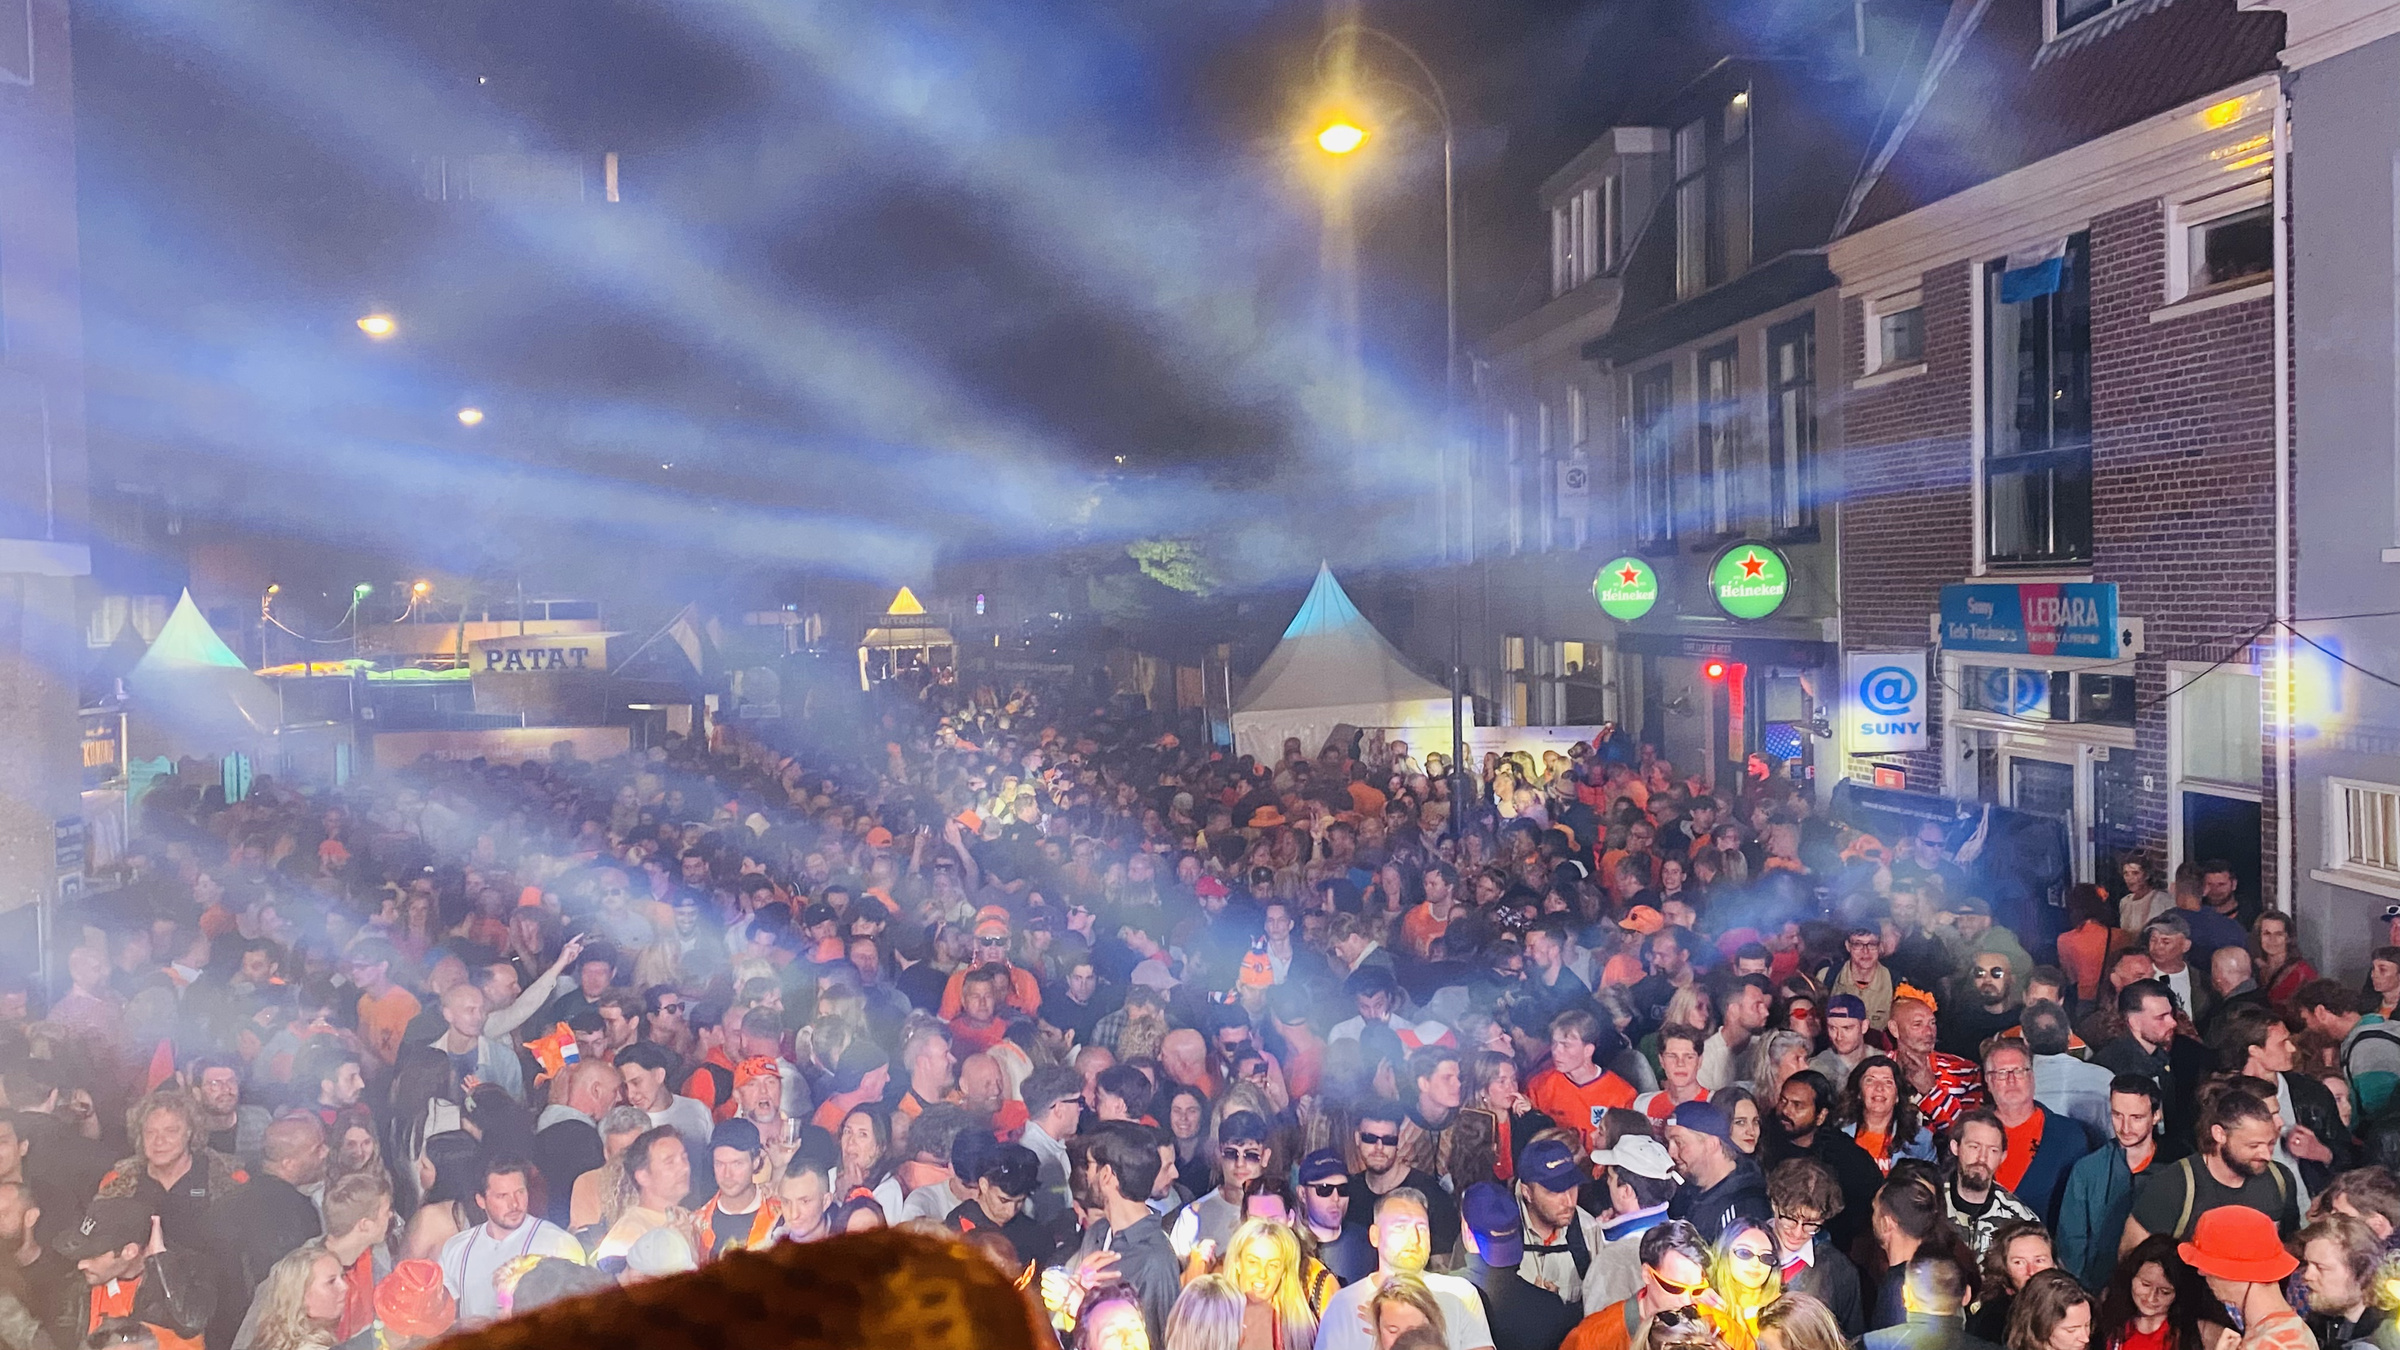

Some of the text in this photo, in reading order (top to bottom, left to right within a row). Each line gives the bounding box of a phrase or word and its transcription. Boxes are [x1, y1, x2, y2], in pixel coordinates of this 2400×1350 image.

[1602, 588, 1656, 601] Heineken
[1721, 581, 1785, 597] Heineken
[880, 615, 934, 625] UITGANG
[2028, 597, 2099, 627] LEBARA
[1947, 621, 1969, 641] Tele
[485, 647, 589, 671] PATAT
[1861, 722, 1921, 735] SUNY
